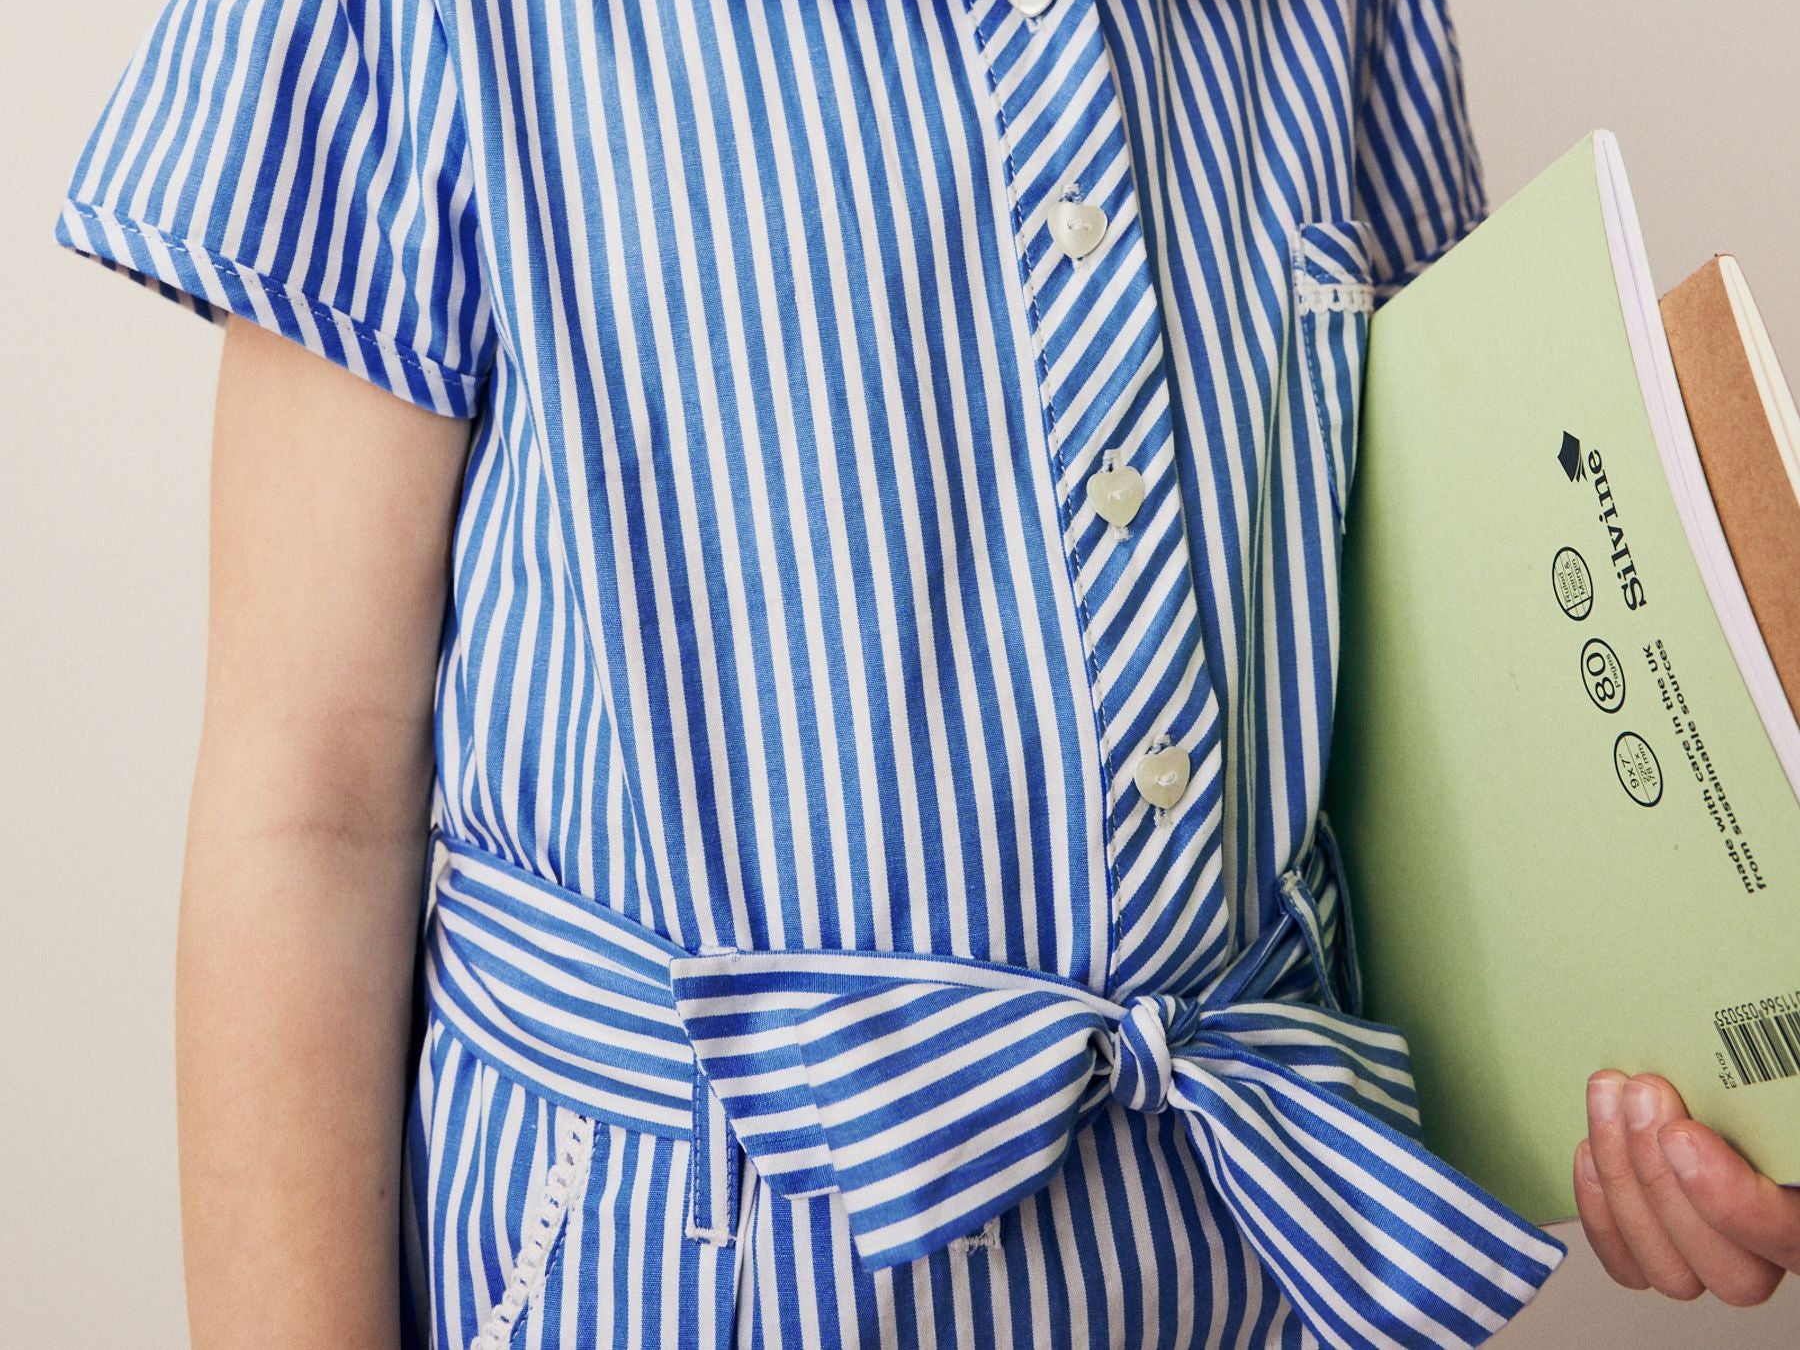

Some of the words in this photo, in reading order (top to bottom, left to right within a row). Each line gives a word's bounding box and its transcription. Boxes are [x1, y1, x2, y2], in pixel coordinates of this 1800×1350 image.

[1588, 449, 1647, 611] Silvine
[1559, 572, 1571, 603] Ruled
[1568, 573, 1579, 599] Feint
[1572, 559, 1586, 596] Margin
[1587, 652, 1615, 702] 80
[1606, 653, 1621, 689] Pages
[1642, 644, 1659, 673] UK
[1655, 639, 1690, 715] sources
[1657, 677, 1674, 711] the
[1672, 716, 1684, 735] in
[1638, 743, 1649, 764] mm
[1682, 739, 1704, 783] care
[1688, 720, 1742, 835] sustainable
[1703, 788, 1726, 833] with
[1725, 838, 1755, 894] made
[1740, 841, 1767, 890] from
[1714, 1002, 1759, 1027] 035035
